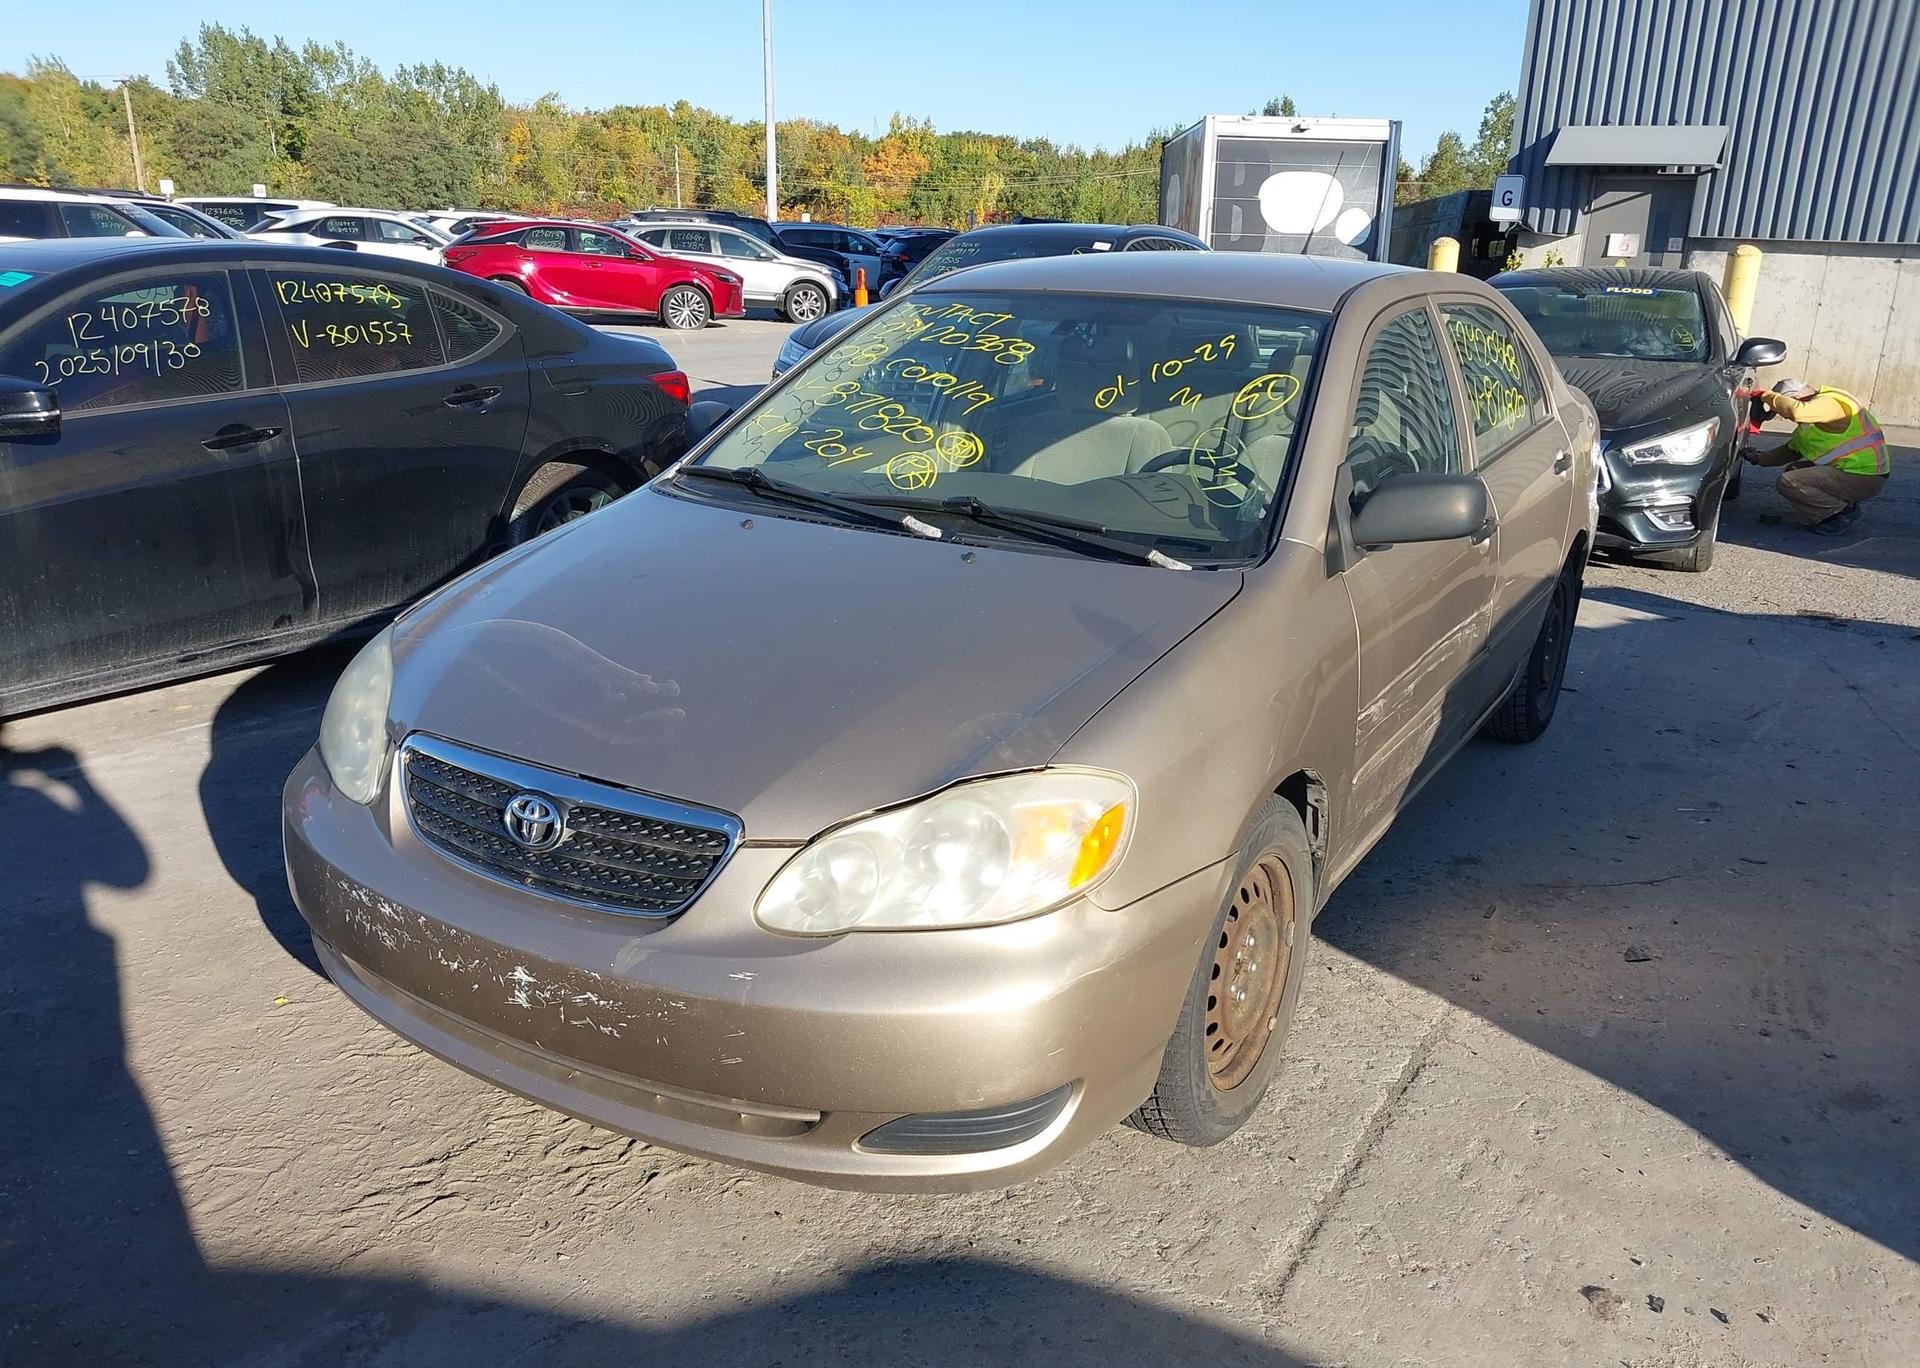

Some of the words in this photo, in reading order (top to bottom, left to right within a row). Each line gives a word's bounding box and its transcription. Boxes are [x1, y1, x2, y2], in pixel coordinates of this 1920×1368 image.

[1501, 190, 1514, 207] G
[277, 280, 401, 309] 12407578
[1605, 286, 1654, 295] FLOOD
[67, 296, 211, 349] 12407578
[888, 302, 1016, 334] INTACT
[291, 319, 413, 349] V-801557
[34, 339, 202, 387] 2025/09/30
